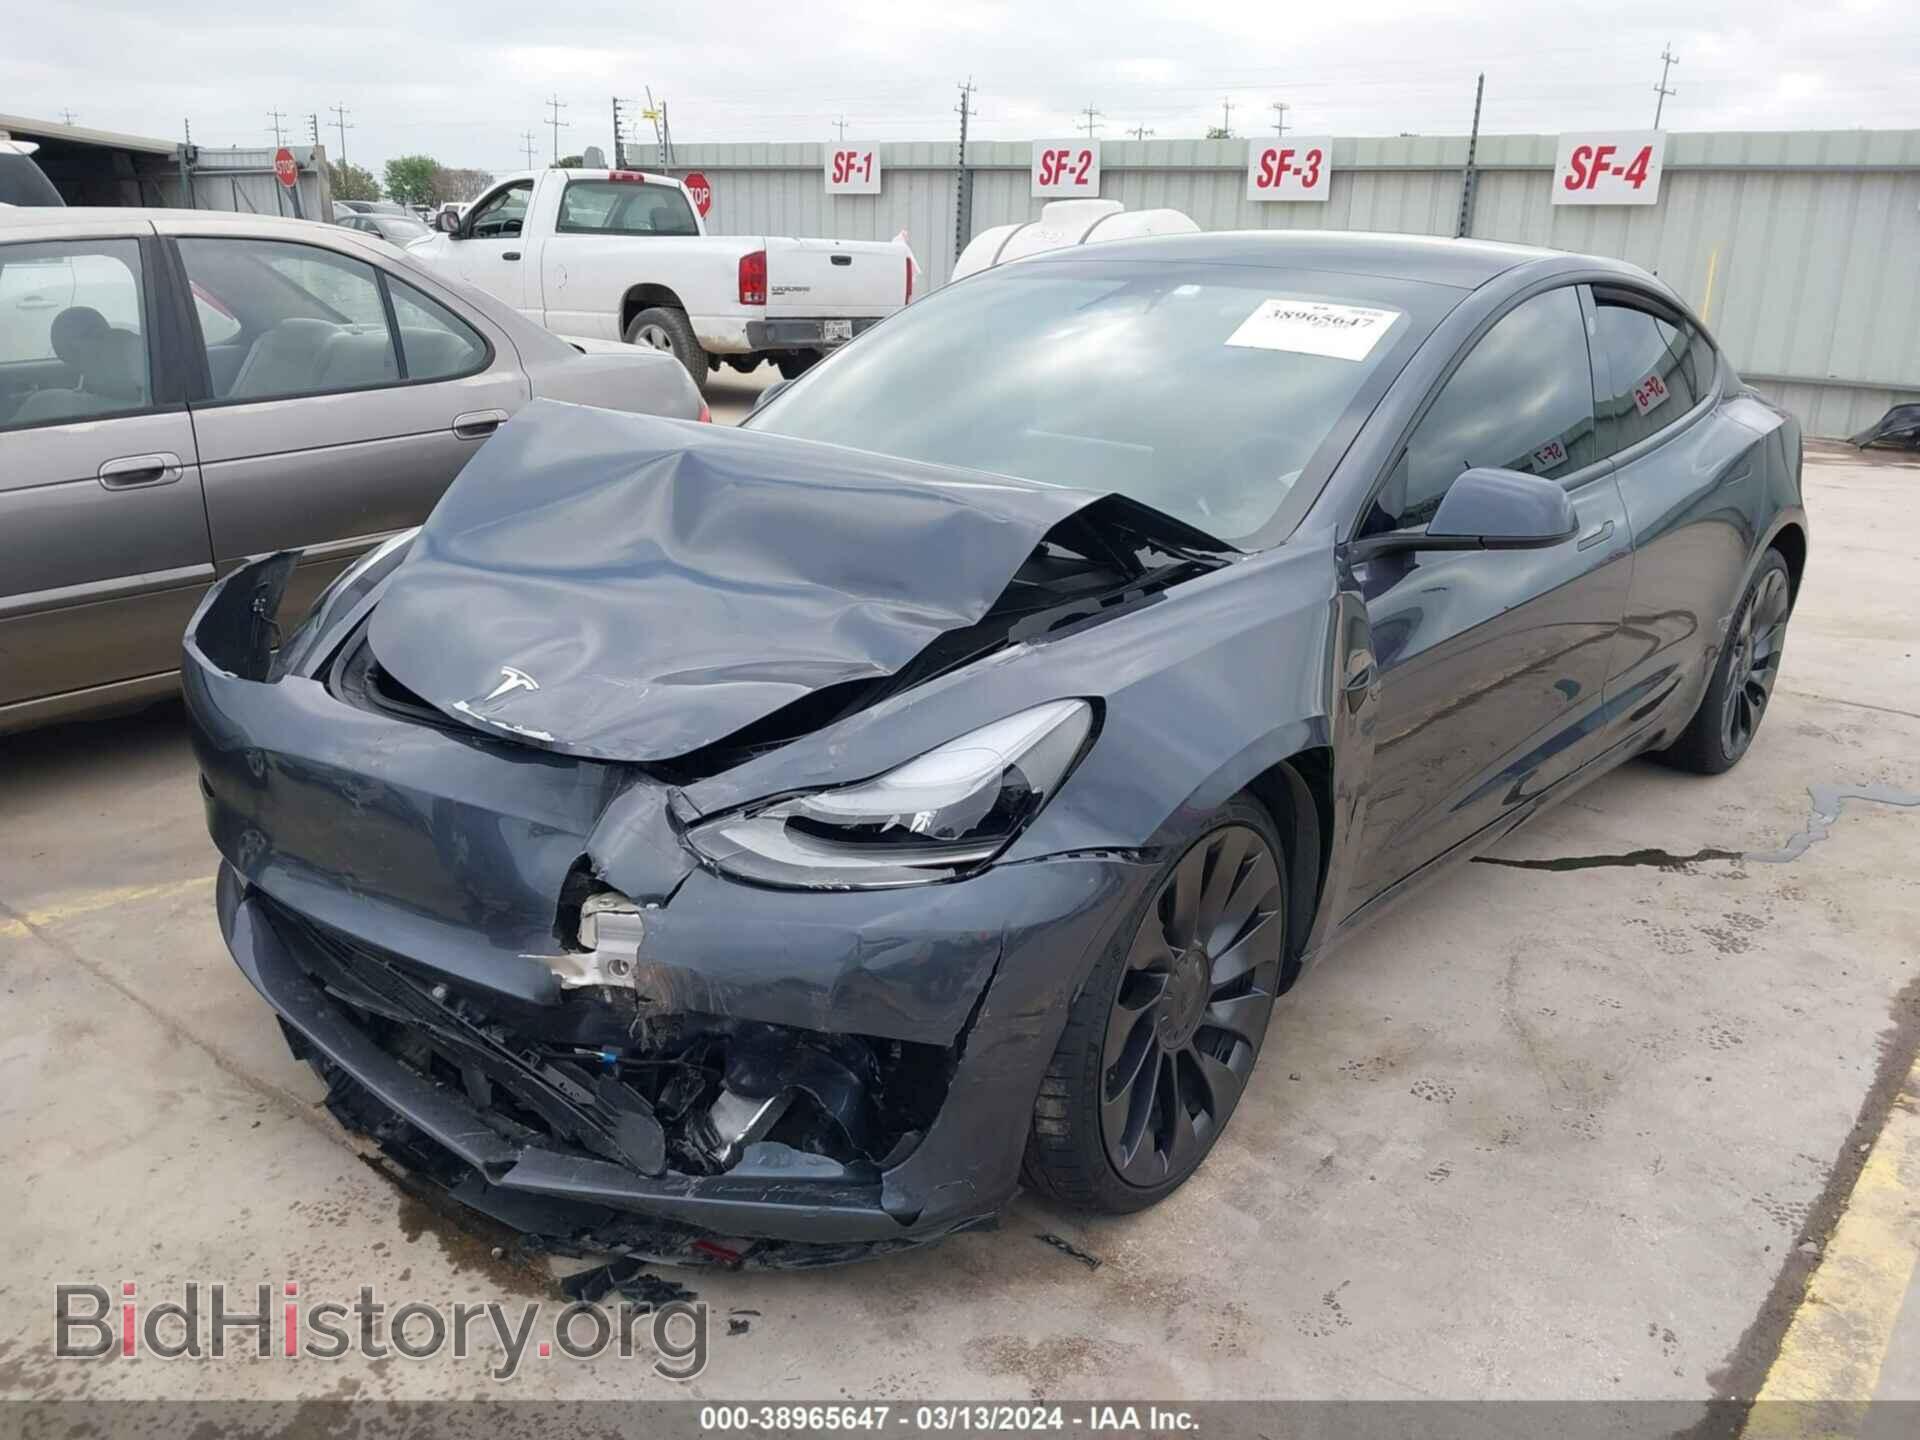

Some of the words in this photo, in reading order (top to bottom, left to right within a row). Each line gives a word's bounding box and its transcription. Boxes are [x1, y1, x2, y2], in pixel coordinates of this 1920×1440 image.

[276, 159, 295, 176] STOP
[832, 151, 873, 183] SF-1
[1039, 149, 1093, 186] SF-2
[1256, 147, 1323, 189] SF-3
[1563, 144, 1653, 191] SF-4
[687, 187, 710, 206] TOP
